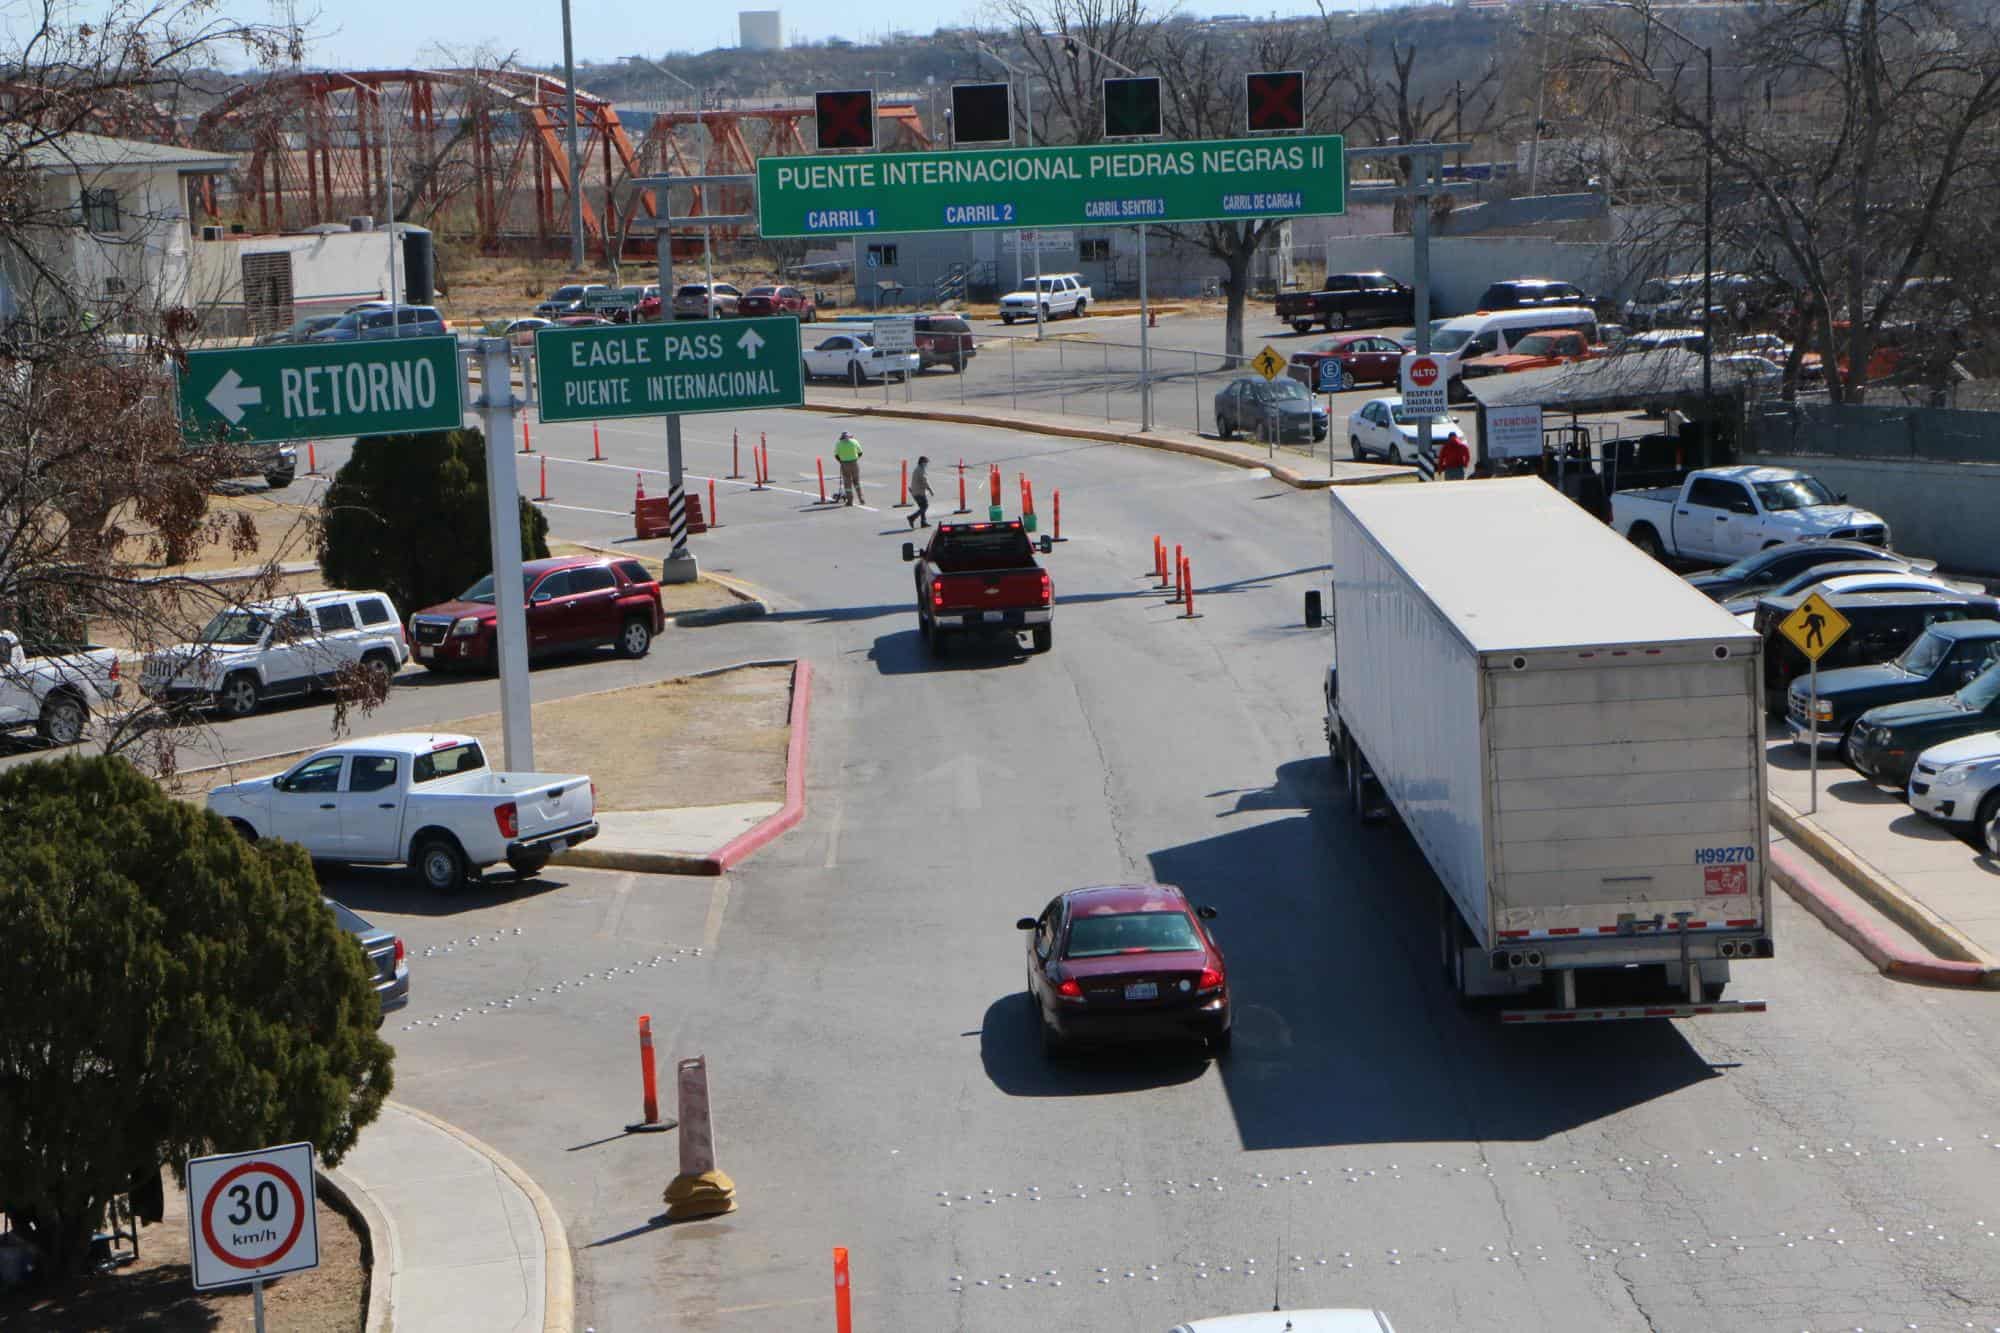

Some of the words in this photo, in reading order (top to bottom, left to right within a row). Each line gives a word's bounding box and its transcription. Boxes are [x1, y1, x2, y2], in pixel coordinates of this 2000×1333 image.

[778, 163, 876, 191] PUENTE
[882, 156, 1082, 185] INTERNACIONAL
[1090, 151, 1195, 179] PIEDRAS
[1202, 146, 1304, 174] NEGRAS
[1311, 146, 1324, 169] II
[1085, 201, 1121, 217] CARRIL
[1122, 200, 1157, 216] SENTRI
[1157, 199, 1164, 215] 3
[1223, 195, 1253, 211] CARRIL
[1254, 194, 1265, 209] DE
[1266, 193, 1293, 209] CARGA
[1294, 192, 1301, 208] 4
[808, 211, 863, 229] CARRIL
[867, 209, 876, 226] 1
[946, 204, 1000, 223] CARRIL
[1003, 203, 1013, 221] 2
[572, 338, 652, 367] EAGLE
[664, 335, 724, 361] PASS
[1412, 368, 1438, 377] ALTO
[280, 358, 436, 418] RETORNO
[564, 378, 632, 406] PUENTE
[647, 369, 780, 401] INTERNACIONAL
[1406, 390, 1444, 398] RESPETAR
[1406, 398, 1431, 406] SALIDA
[1433, 397, 1444, 405] DE
[1695, 846, 1755, 865] H99270
[228, 1180, 279, 1226] 30
[233, 1229, 277, 1246] km/h
